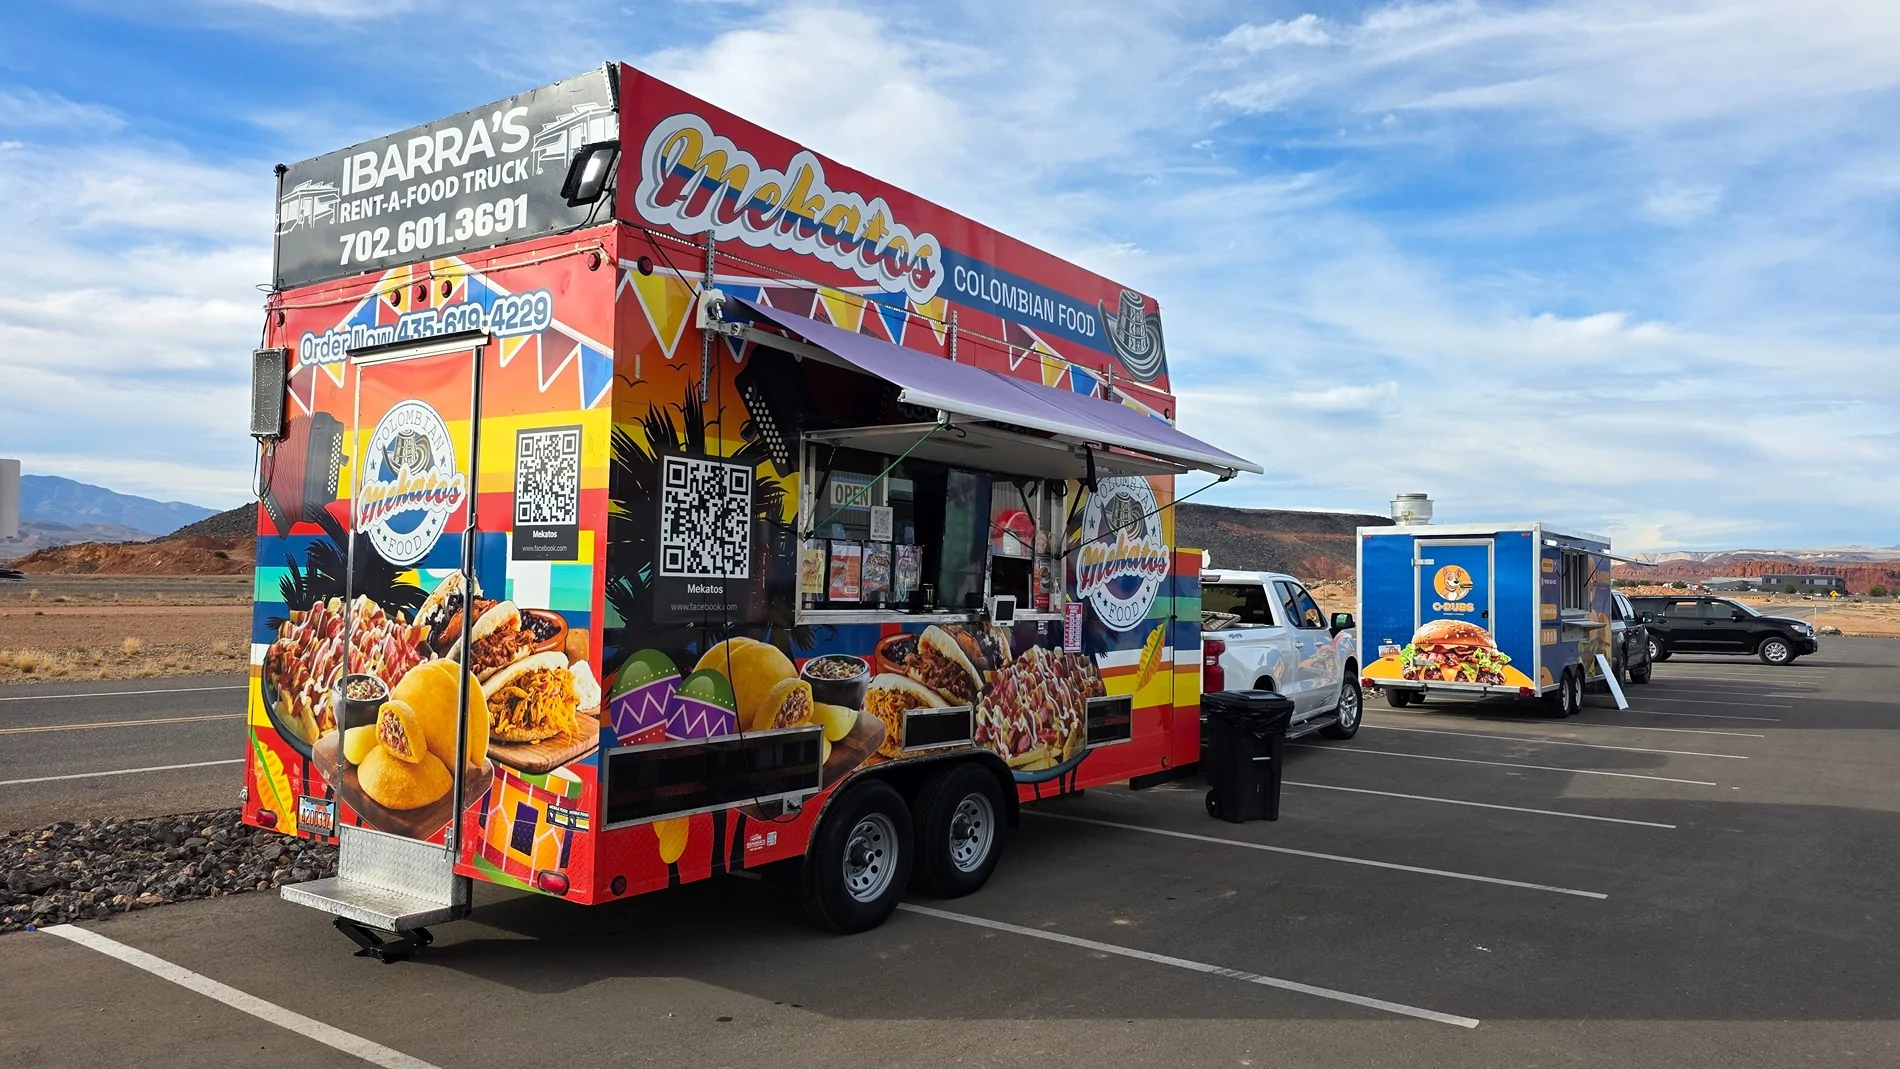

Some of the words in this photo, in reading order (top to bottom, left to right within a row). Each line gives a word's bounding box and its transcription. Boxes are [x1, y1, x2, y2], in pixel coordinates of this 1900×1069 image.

[342, 106, 531, 196] IBARRA'S
[340, 176, 459, 223] RENT-A-FOOD
[463, 157, 530, 195] TRUCK
[650, 125, 937, 282] Mekatos
[340, 194, 529, 265] 702.601.3691
[953, 264, 1055, 323] COLOMBIAN
[1058, 304, 1096, 338] FOOD
[303, 335, 349, 361] Order
[261, 358, 274, 428] OPEN
[375, 409, 445, 453] COLOMBIAN
[360, 468, 462, 526] Mekatos
[835, 483, 869, 506] OPEN
[387, 534, 422, 556] FOOD
[522, 544, 568, 552] www.facebook.com
[532, 529, 558, 539] Mekatos
[1080, 530, 1168, 591] Mekatos
[687, 583, 724, 594] Mekatos
[1432, 601, 1475, 612] C-DUBS
[1108, 601, 1140, 622] FOOD
